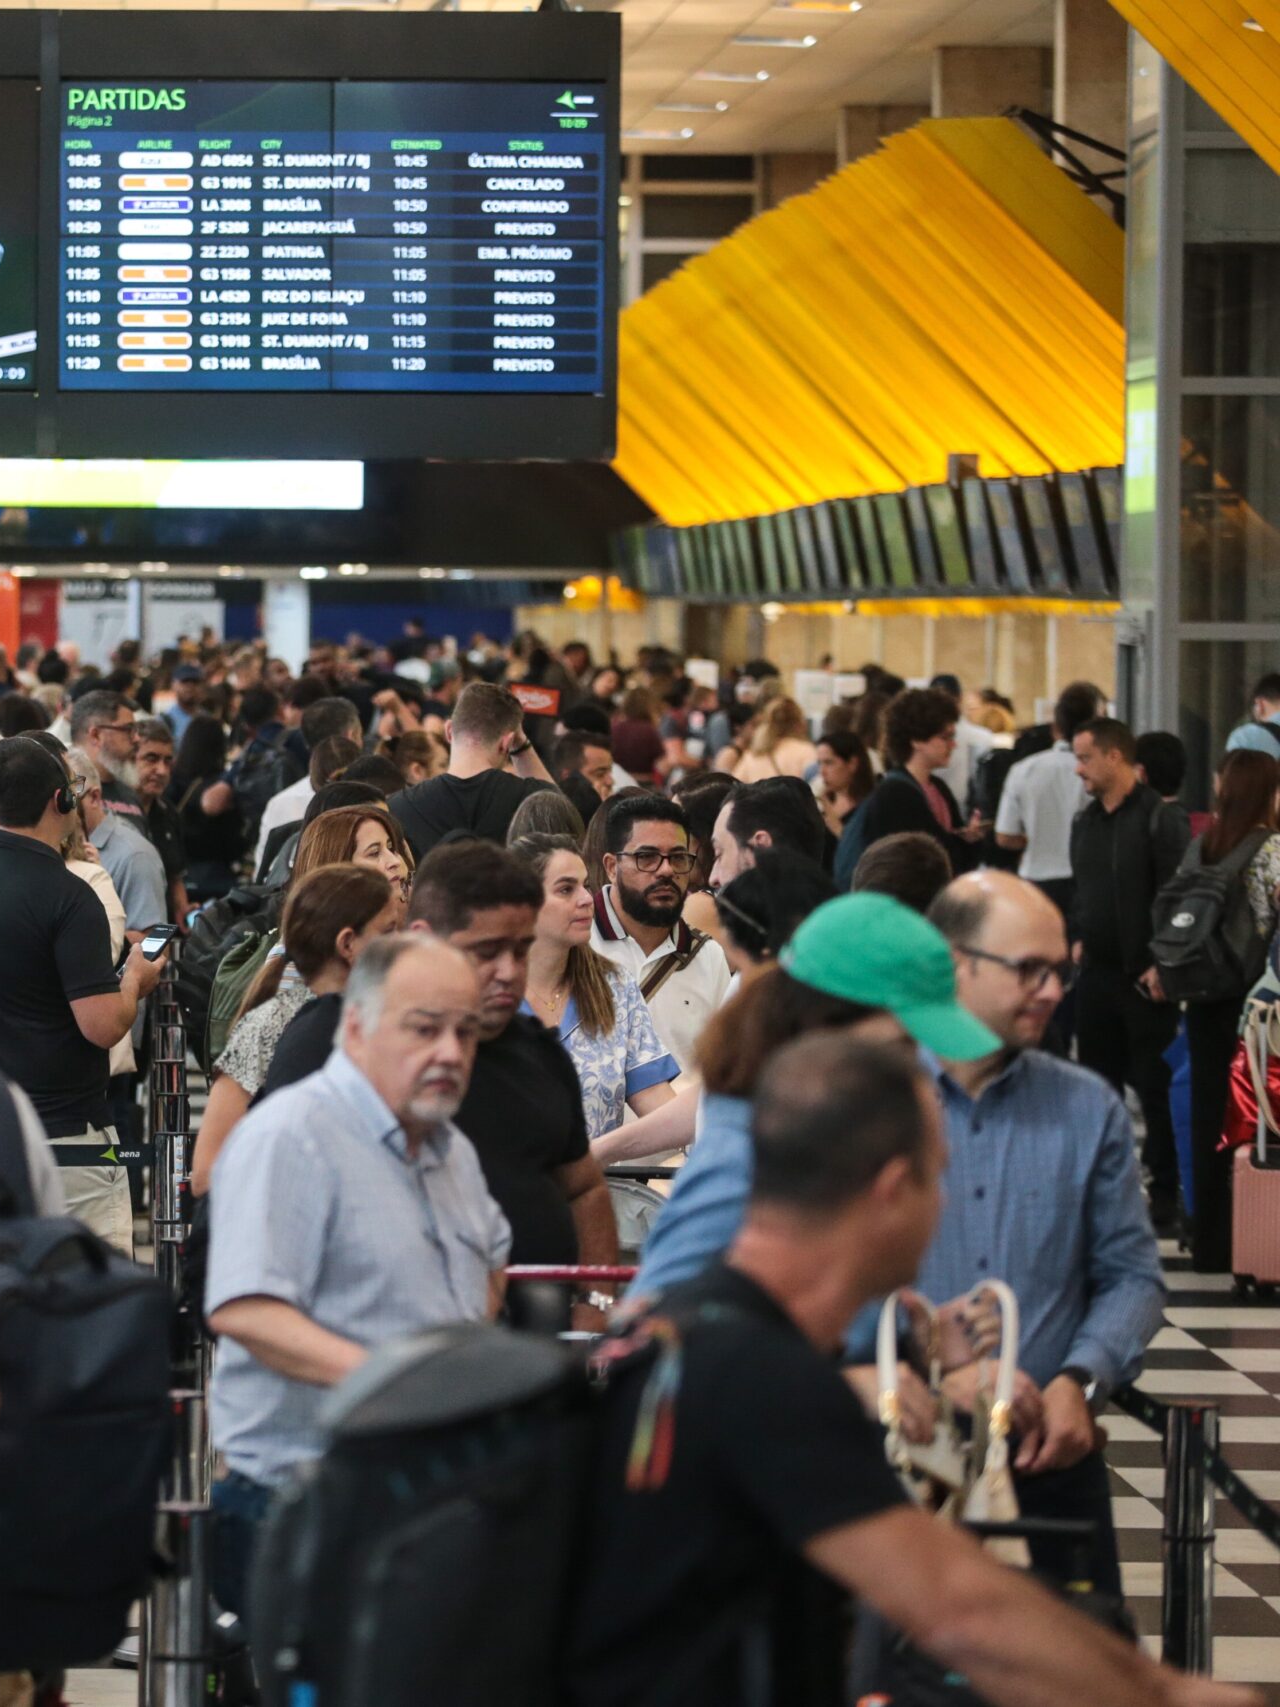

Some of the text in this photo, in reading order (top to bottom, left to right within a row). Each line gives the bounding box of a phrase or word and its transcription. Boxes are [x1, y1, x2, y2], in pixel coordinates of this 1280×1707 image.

[68, 89, 185, 110] PARTIDAS
[68, 115, 112, 128] Página 2
[468, 153, 517, 167] ÚLTIMA
[487, 178, 564, 190] CANCELADO
[263, 197, 321, 211] BRASÍLIA
[482, 200, 569, 213] CONFIRMADO
[495, 223, 555, 235] PREVISTO
[262, 268, 331, 280] SALVADOR
[494, 270, 555, 282] PREVISTO
[494, 292, 555, 304] PREVISTO
[494, 314, 554, 327] PREVISTO
[494, 336, 554, 349] PREVISTO
[494, 359, 554, 371] PREVISTO
